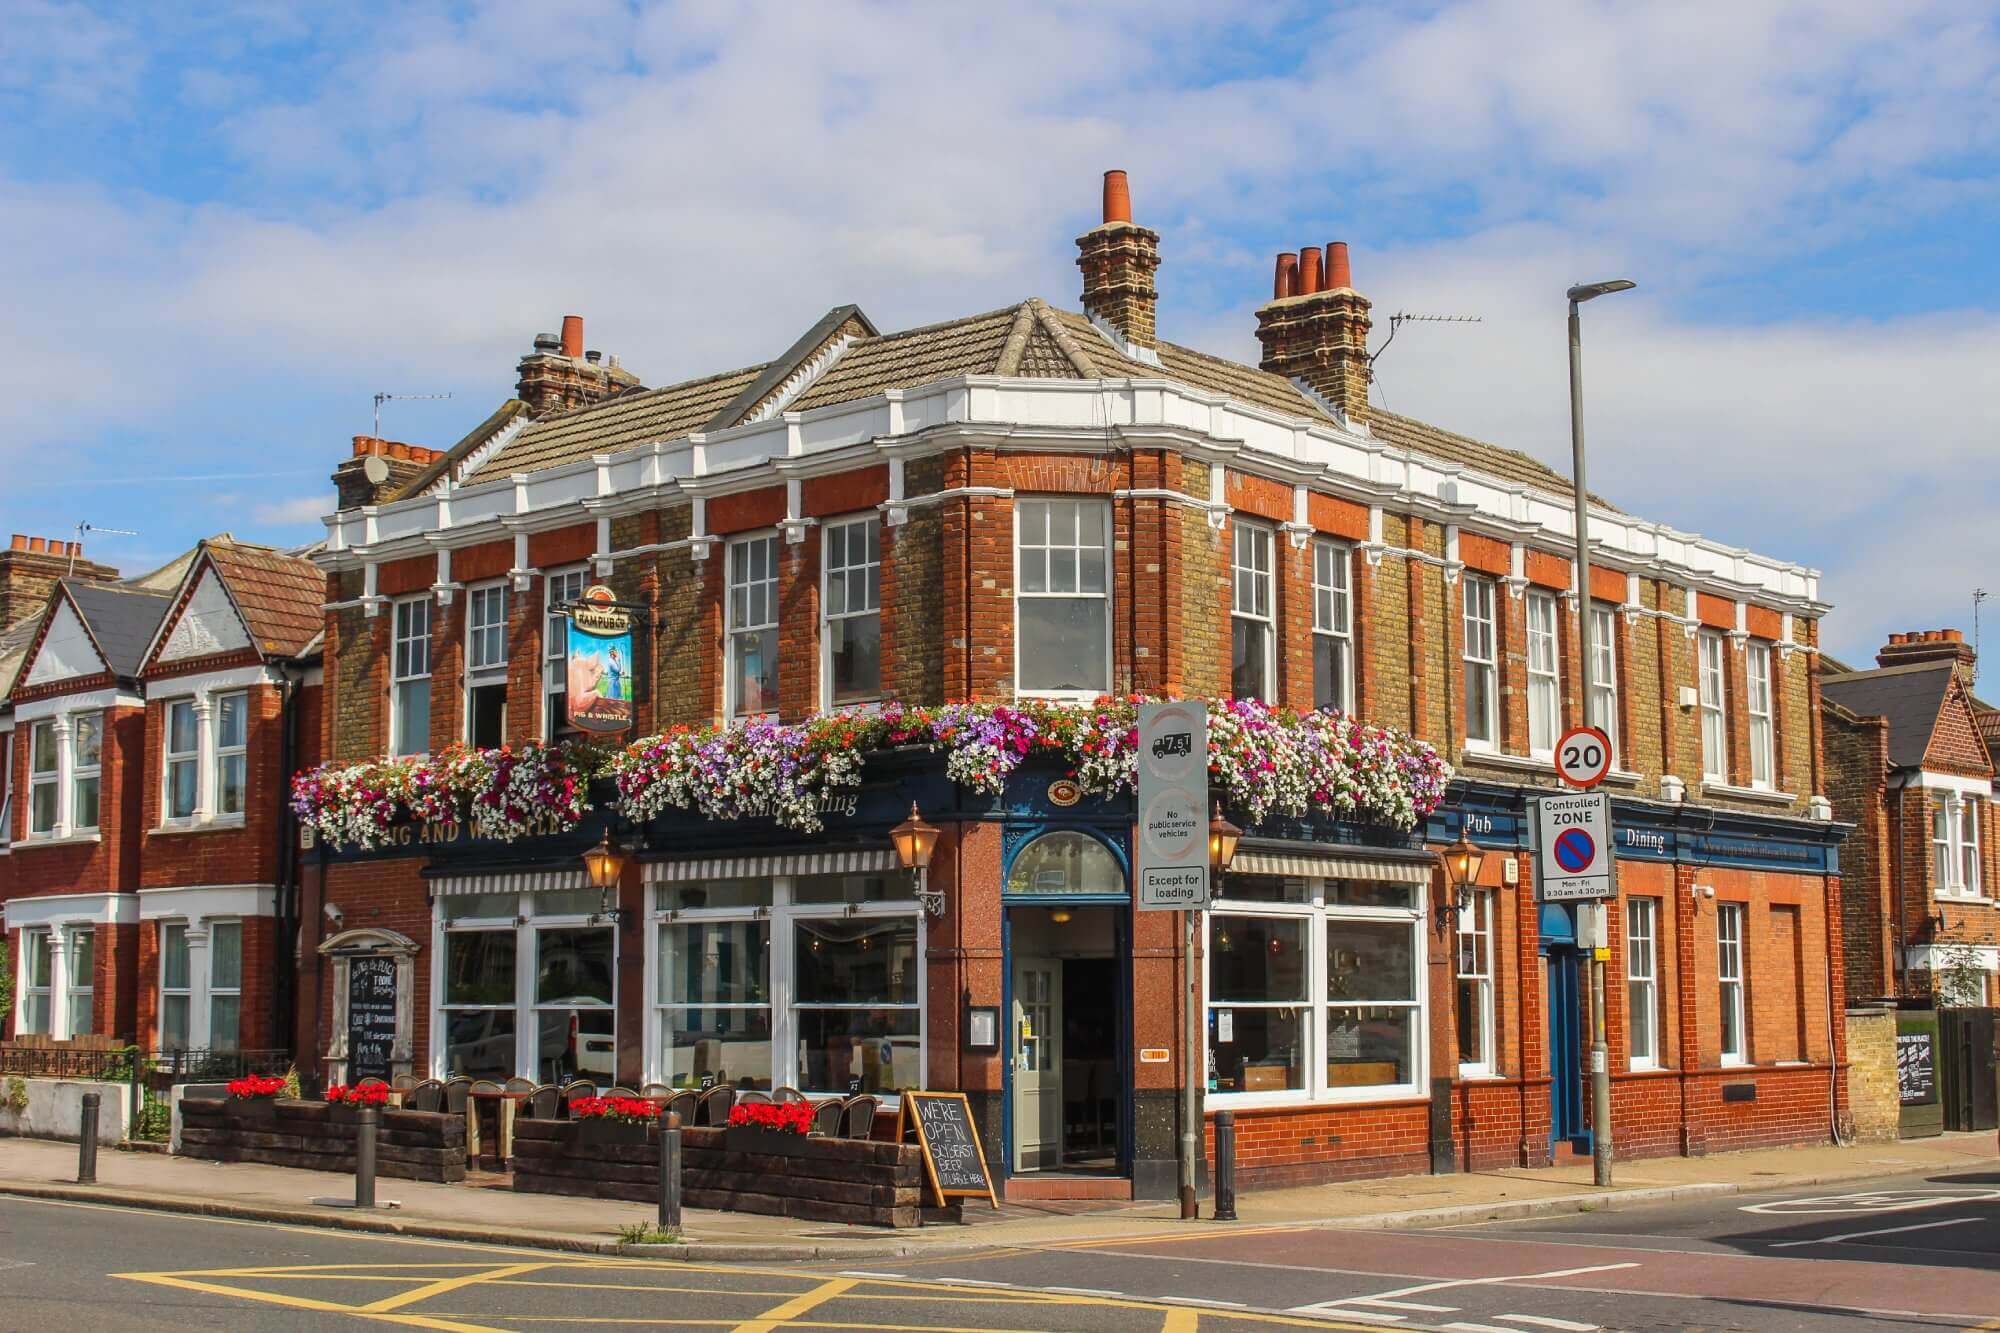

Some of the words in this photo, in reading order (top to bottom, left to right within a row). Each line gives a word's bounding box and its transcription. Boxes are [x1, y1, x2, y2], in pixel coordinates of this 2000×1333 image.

[595, 712, 627, 720] WHISTLE
[1564, 745, 1602, 769] 20
[1544, 797, 1600, 811] Controlled
[1167, 811, 1178, 819] No
[1553, 811, 1593, 825] ZONE
[418, 818, 459, 844] AND
[469, 814, 560, 840] WTLE
[1149, 821, 1171, 831] public
[1172, 820, 1196, 828] service
[1467, 813, 1492, 834] Pub
[1159, 830, 1188, 838] vehicles
[1626, 828, 1664, 855] Dining
[1149, 875, 1183, 886] Except
[1185, 874, 1199, 885] for
[1155, 887, 1194, 899] loading
[1578, 887, 1595, 895] 4.30
[916, 1099, 961, 1121] WE'RE
[924, 1121, 967, 1142] OPEN
[938, 1159, 962, 1172] BEER
